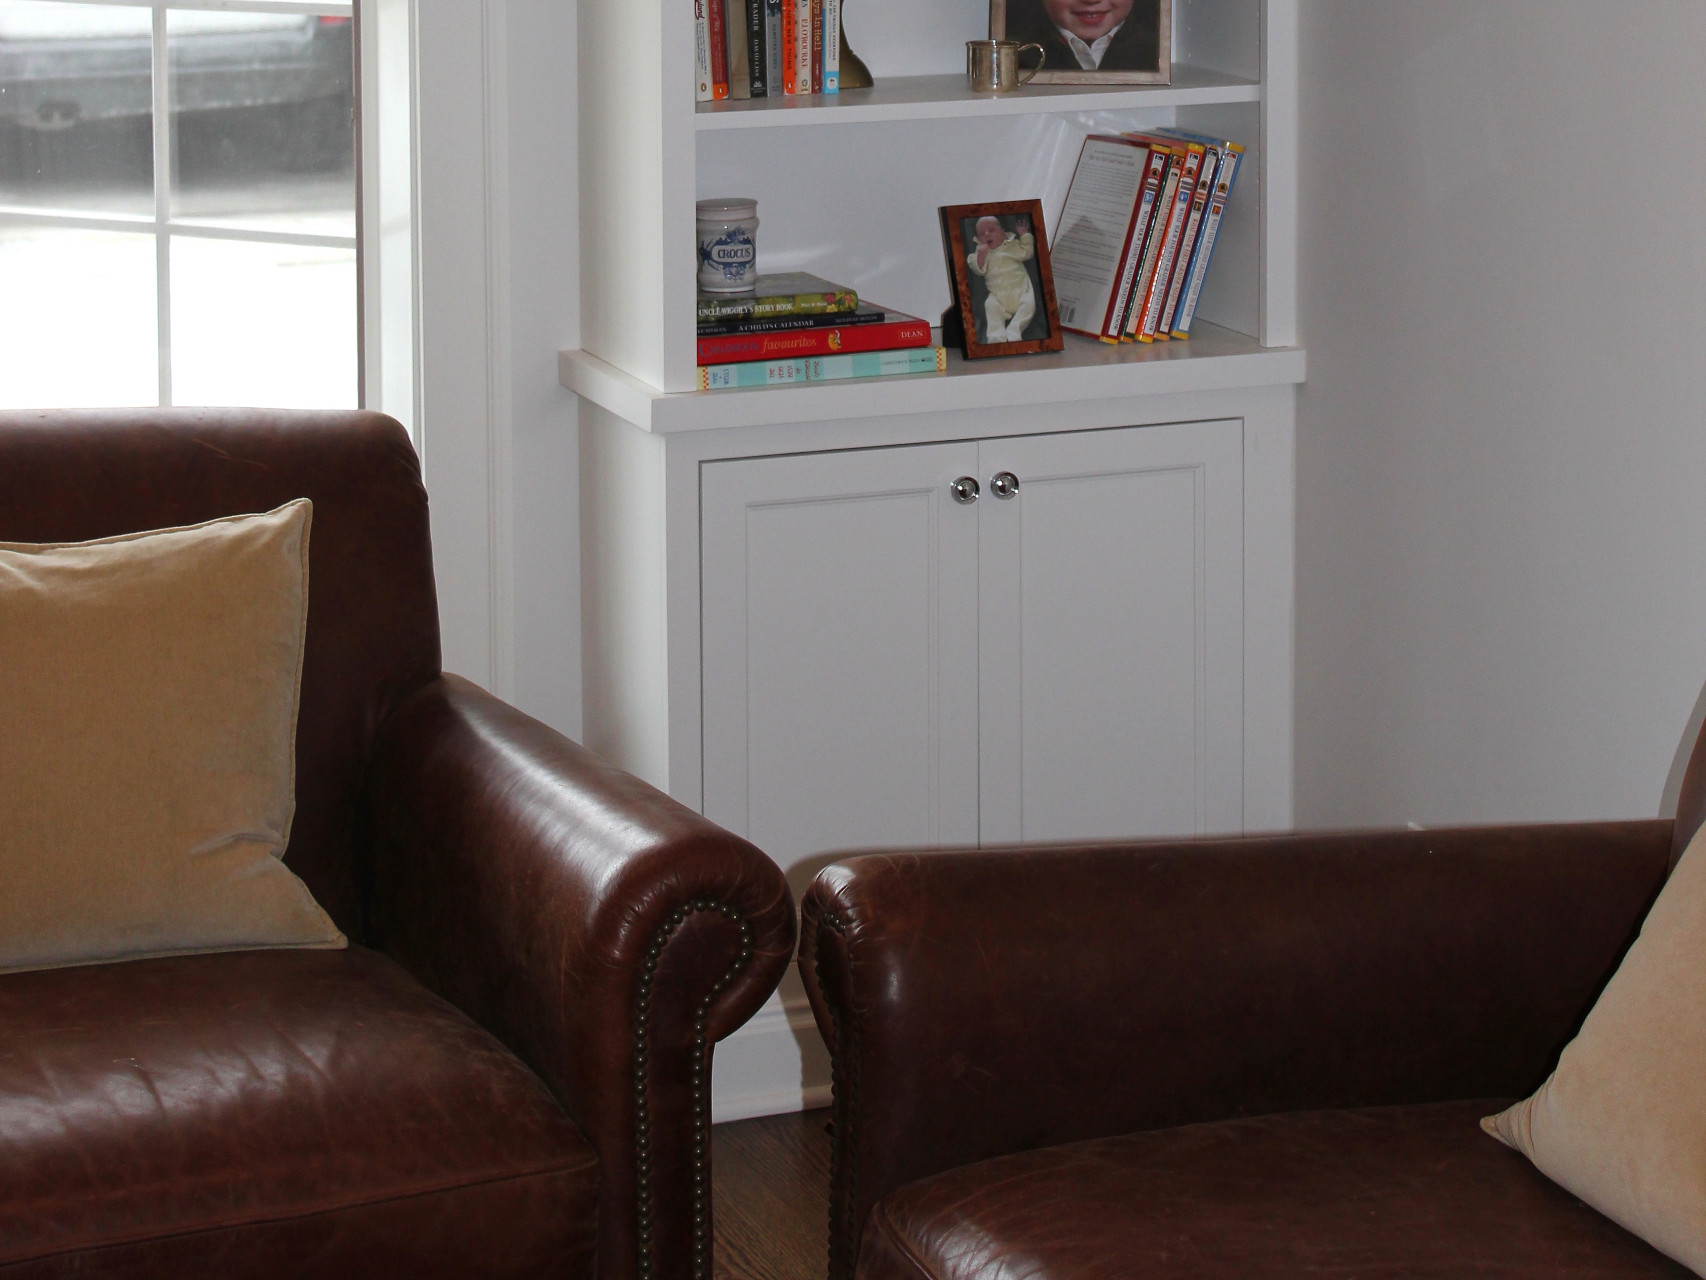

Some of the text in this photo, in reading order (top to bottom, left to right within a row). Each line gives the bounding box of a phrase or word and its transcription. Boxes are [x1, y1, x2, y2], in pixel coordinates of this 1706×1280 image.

[713, 20, 721, 32] Tea
[814, 15, 821, 26] in
[718, 248, 751, 259] CROCUS
[1132, 242, 1140, 261] THIRD
[1120, 286, 1128, 304] NEEDS
[1155, 287, 1163, 305] NEEDS
[699, 303, 793, 317] UNCLE WIGGILY'S STORY BOOK
[1117, 305, 1123, 313] TO
[1152, 307, 1158, 315] TO
[745, 322, 774, 331] CHILD'S
[774, 320, 815, 329] CALENDAR
[1112, 313, 1121, 330] KNOW
[1148, 315, 1156, 331] KNOW
[761, 336, 817, 354] favourites
[900, 330, 923, 339] DEAN
